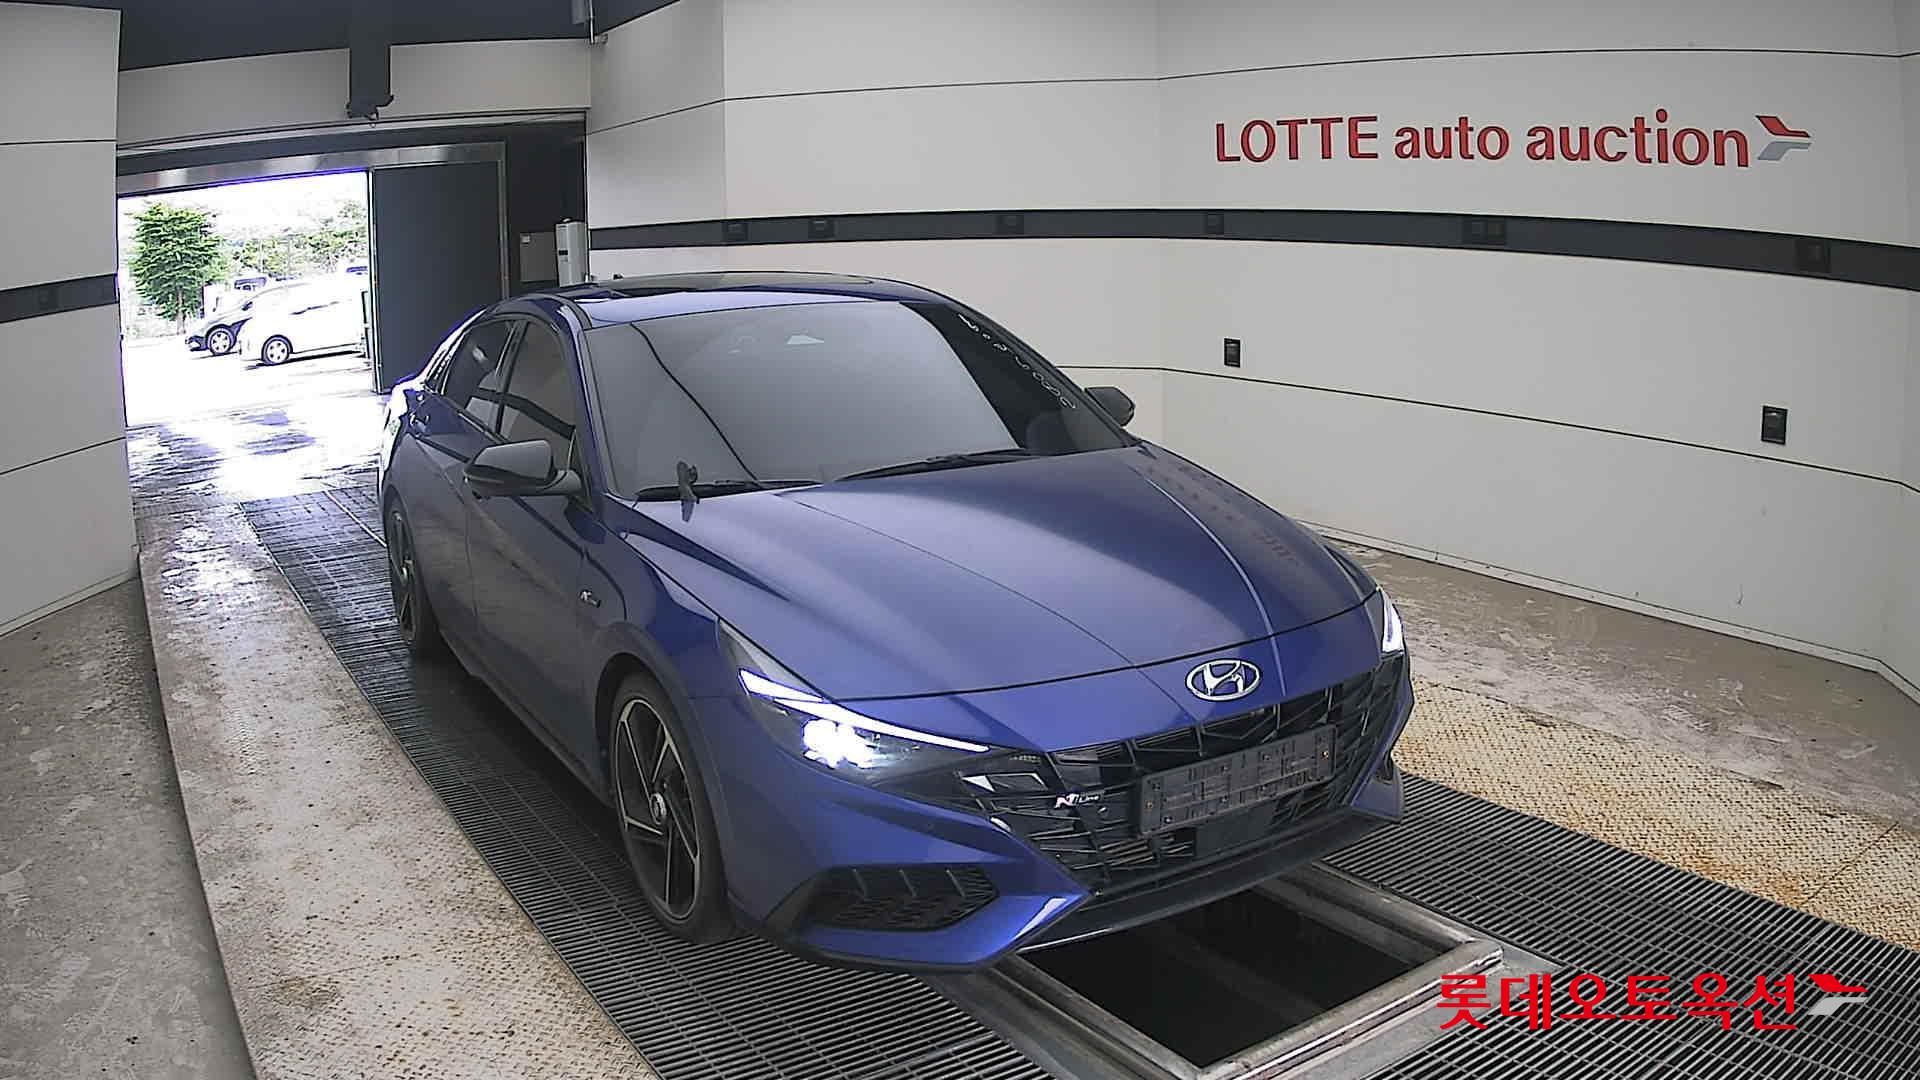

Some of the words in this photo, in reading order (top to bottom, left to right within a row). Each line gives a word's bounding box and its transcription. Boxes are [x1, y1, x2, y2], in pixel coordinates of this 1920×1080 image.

[1215, 115, 1379, 162] LOTTE
[1394, 115, 1510, 161] auto
[1525, 108, 1750, 168] auction
